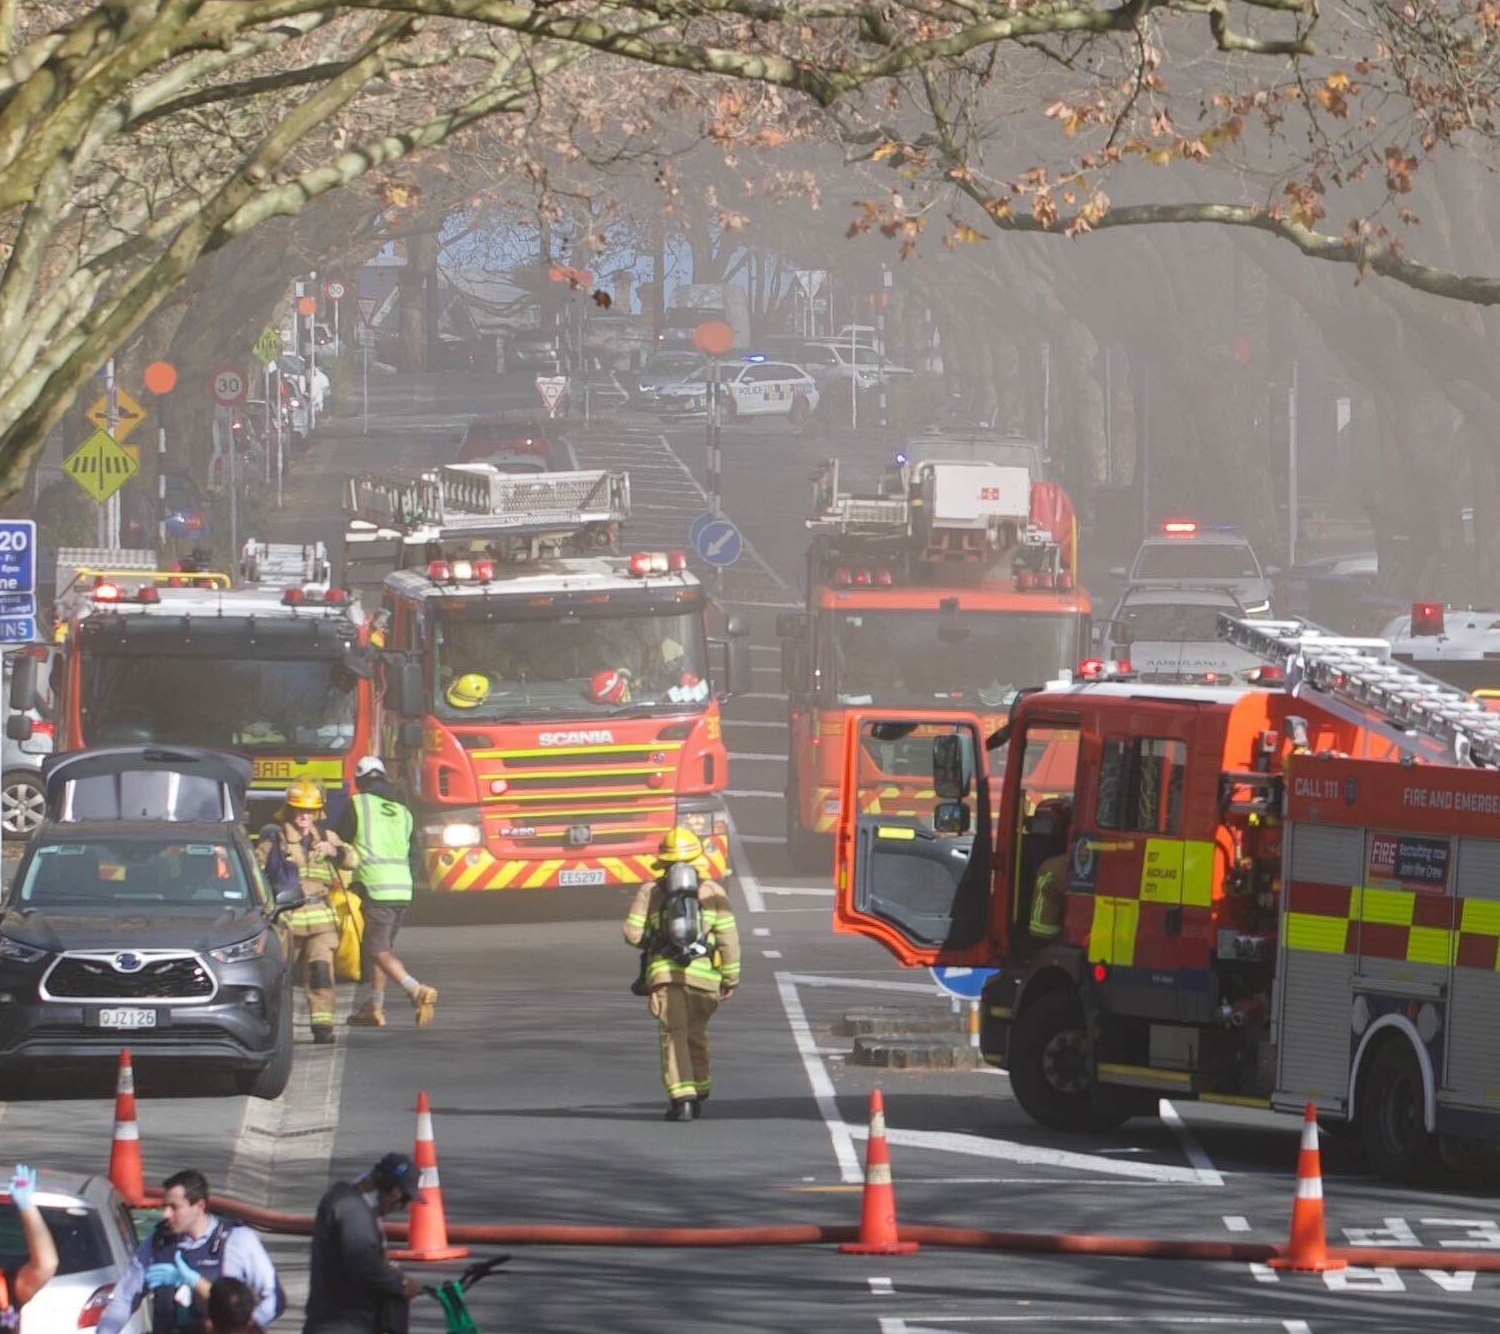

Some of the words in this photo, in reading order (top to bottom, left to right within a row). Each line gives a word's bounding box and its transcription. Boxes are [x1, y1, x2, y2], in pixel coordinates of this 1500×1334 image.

[218, 378, 239, 393] 30
[539, 730, 614, 747] SCANIA
[1294, 777, 1321, 798] CALL
[1324, 780, 1339, 799] 111
[1404, 787, 1427, 807] FIRE
[1429, 790, 1452, 809] AND
[1372, 840, 1397, 865] FIRE
[560, 870, 604, 885] EES297
